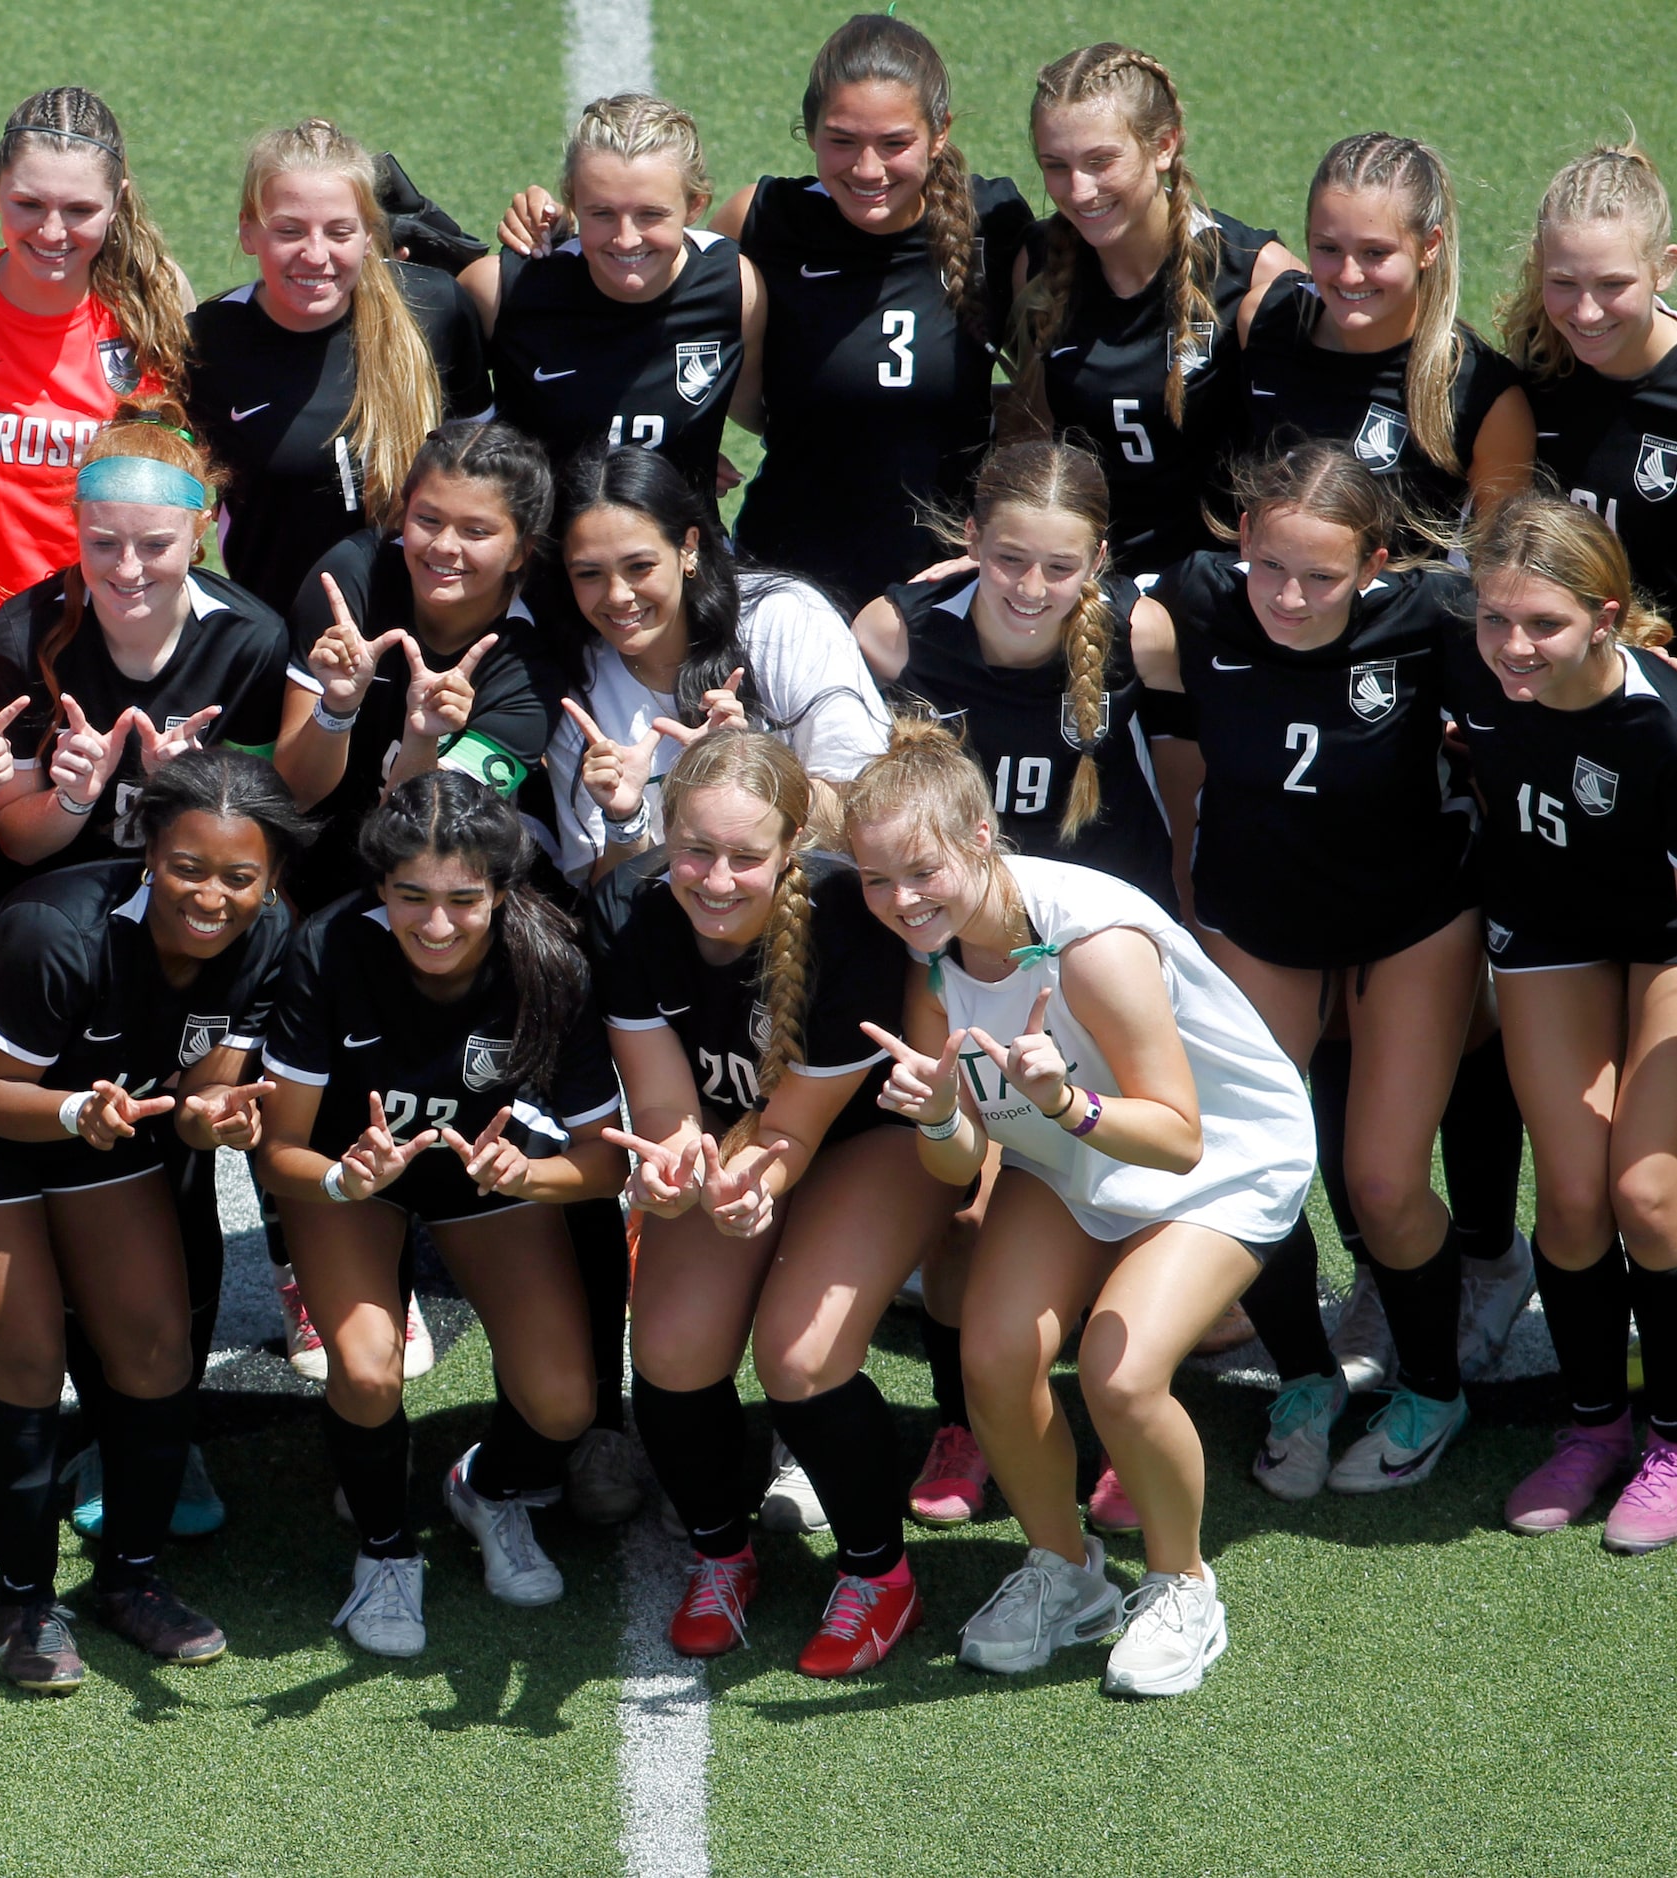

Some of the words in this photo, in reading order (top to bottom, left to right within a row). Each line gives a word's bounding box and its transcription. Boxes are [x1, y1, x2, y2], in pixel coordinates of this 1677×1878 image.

[878, 310, 915, 387] 3
[1113, 399, 1154, 462] 5
[482, 753, 515, 788] C
[994, 756, 1051, 813] 19
[1283, 723, 1318, 793] 2
[1517, 782, 1567, 847] 15
[699, 1047, 760, 1109] 20
[384, 1089, 458, 1148] 23
[979, 1104, 1031, 1121] rosper
